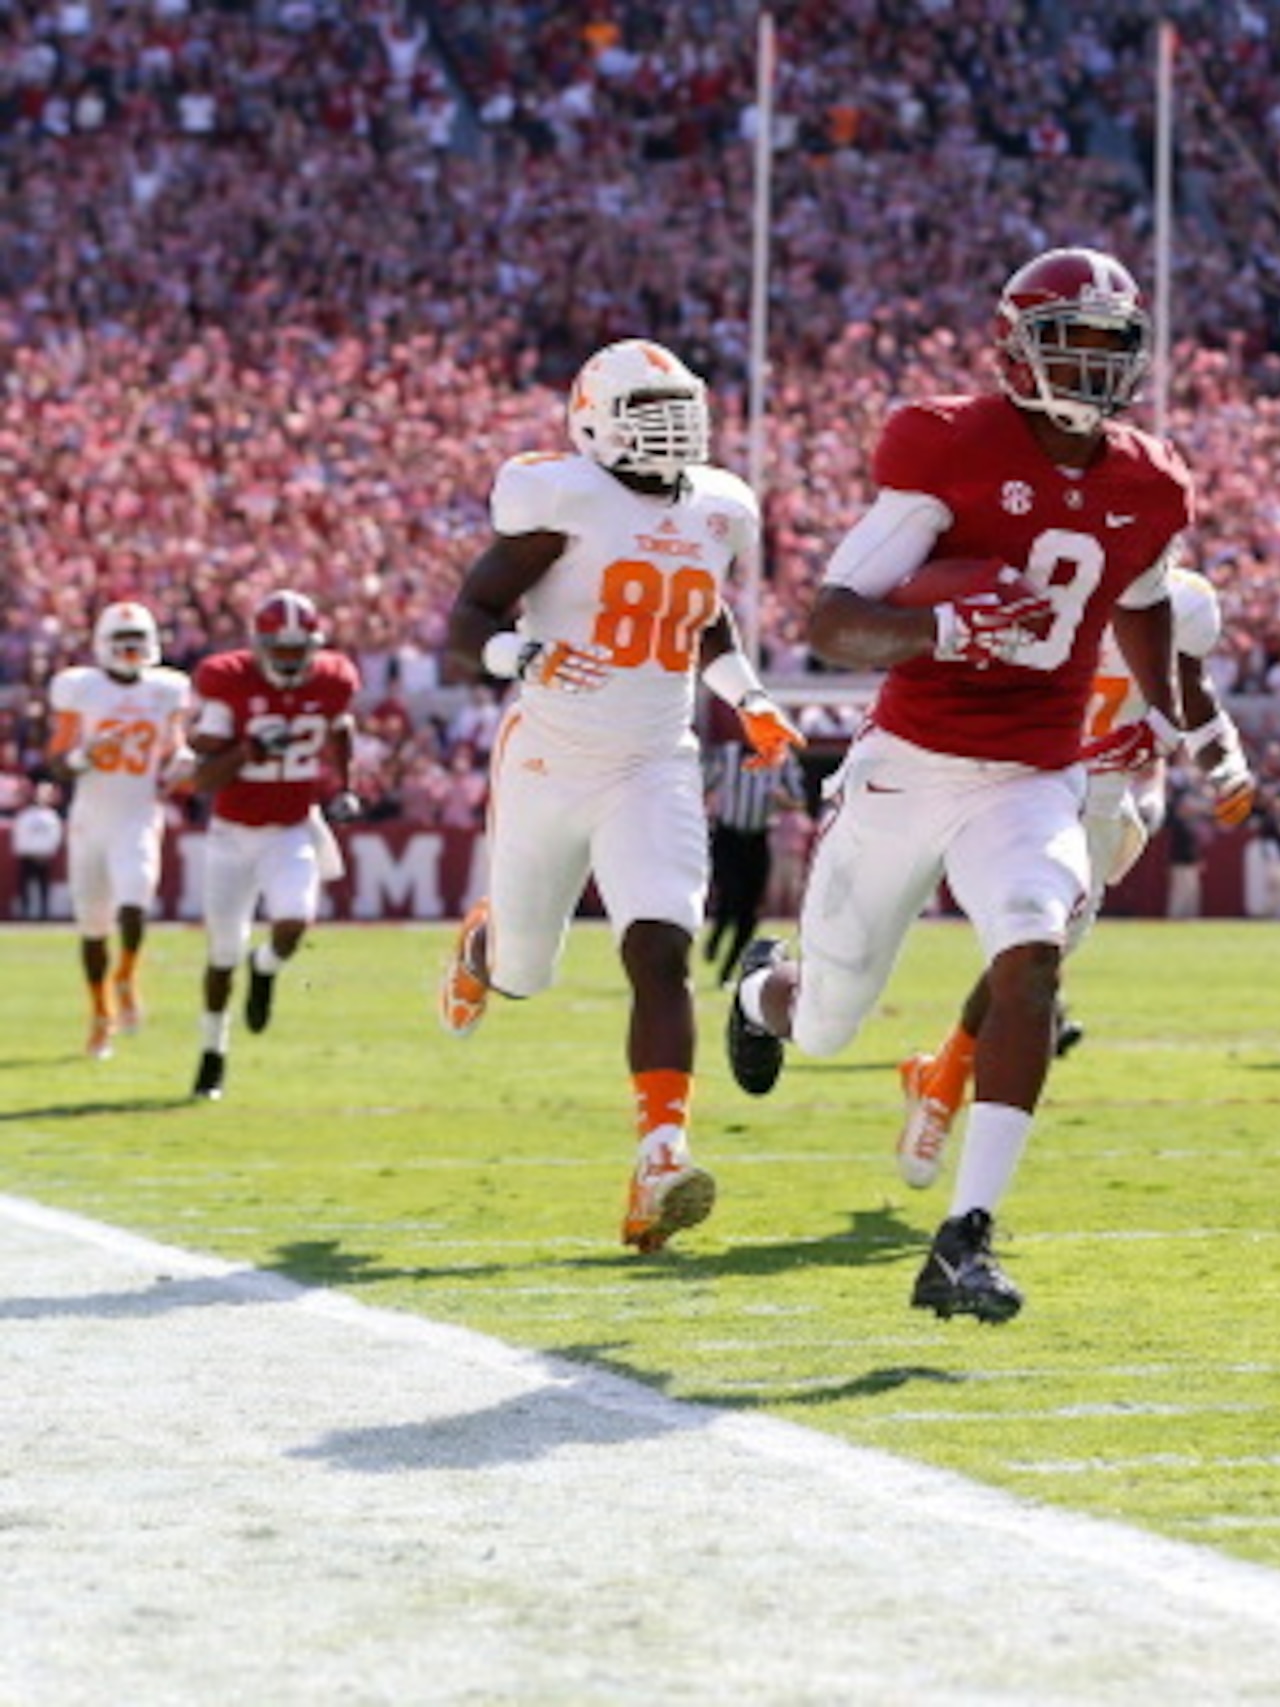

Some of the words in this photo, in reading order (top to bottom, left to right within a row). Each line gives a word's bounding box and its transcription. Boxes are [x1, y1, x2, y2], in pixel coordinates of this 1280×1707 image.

[592, 559, 716, 673] 80
[1090, 677, 1130, 737] 7
[239, 714, 326, 782] 22
